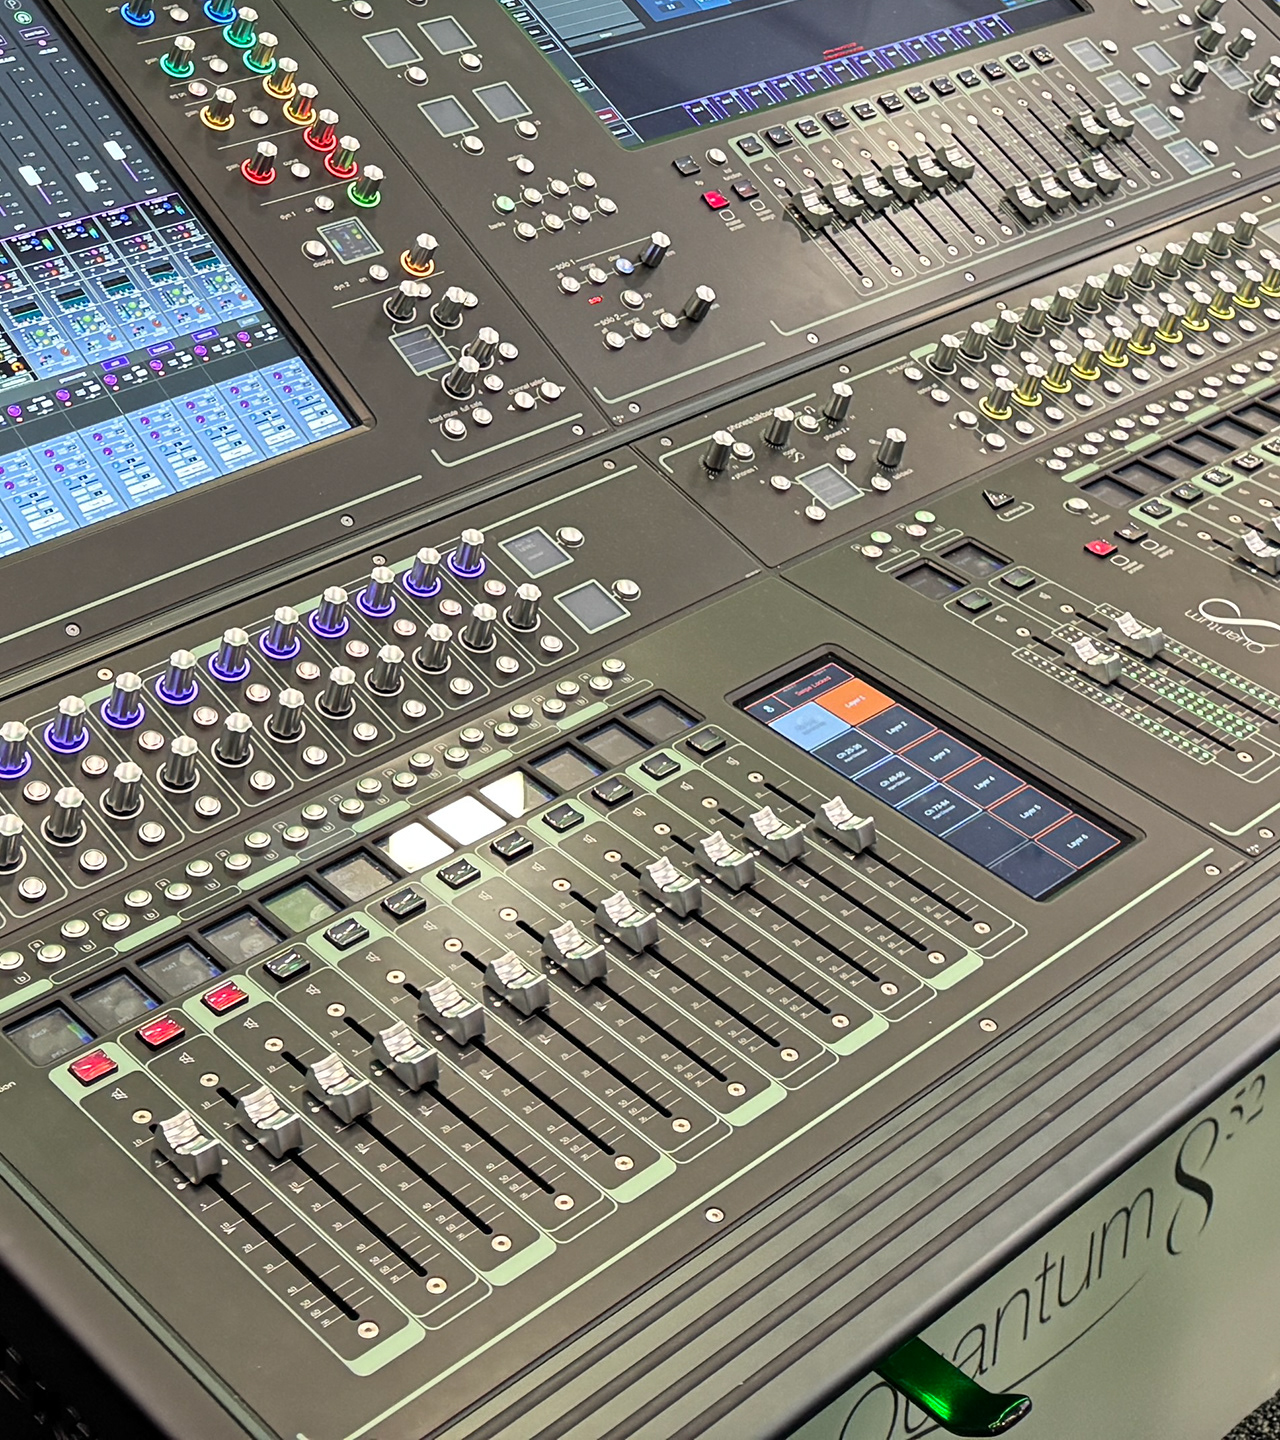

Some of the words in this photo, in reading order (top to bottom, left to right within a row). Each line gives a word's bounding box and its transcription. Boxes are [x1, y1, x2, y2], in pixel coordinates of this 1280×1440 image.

[555, 260, 571, 271] solo
[600, 316, 616, 327] solo
[507, 383, 529, 396] channel
[845, 697, 861, 709] Layer
[886, 723, 903, 735] Layer
[930, 750, 945, 762] Layer
[974, 778, 989, 790] Layer
[1020, 807, 1035, 820] Layer
[1066, 836, 1082, 850] Layer
